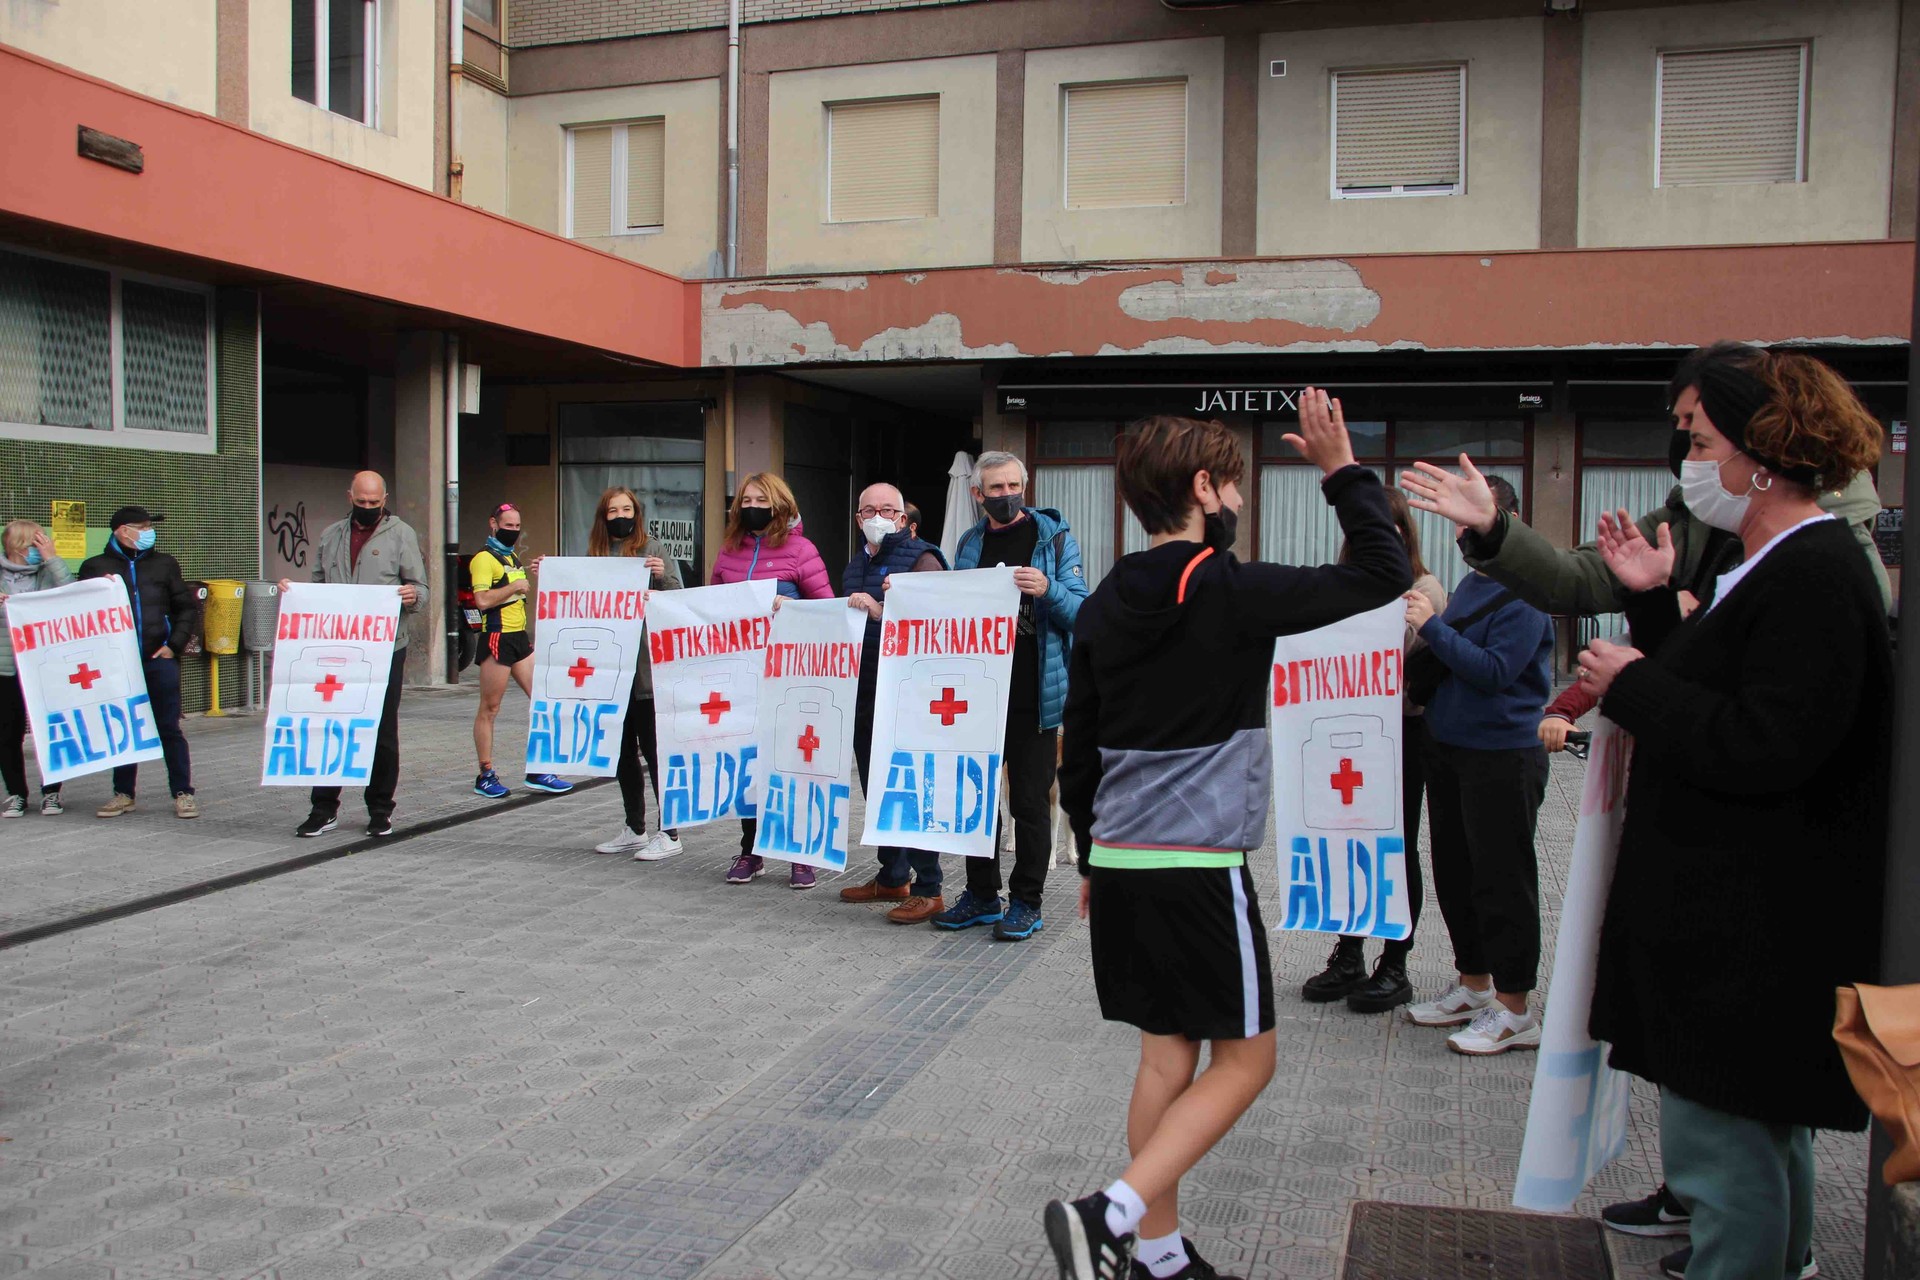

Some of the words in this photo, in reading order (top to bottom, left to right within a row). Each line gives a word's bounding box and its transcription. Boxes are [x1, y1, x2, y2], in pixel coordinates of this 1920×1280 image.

[649, 520, 660, 539] SE
[661, 521, 693, 541] ALQUILA
[673, 544, 683, 558] 60
[684, 545, 693, 558] 44
[47, 694, 162, 772] ALDE
[265, 715, 376, 779] ALDE
[526, 700, 620, 769] ALDE
[662, 744, 759, 826] ALDE
[758, 774, 850, 865] ALDE
[1281, 836, 1406, 938] ALDE
